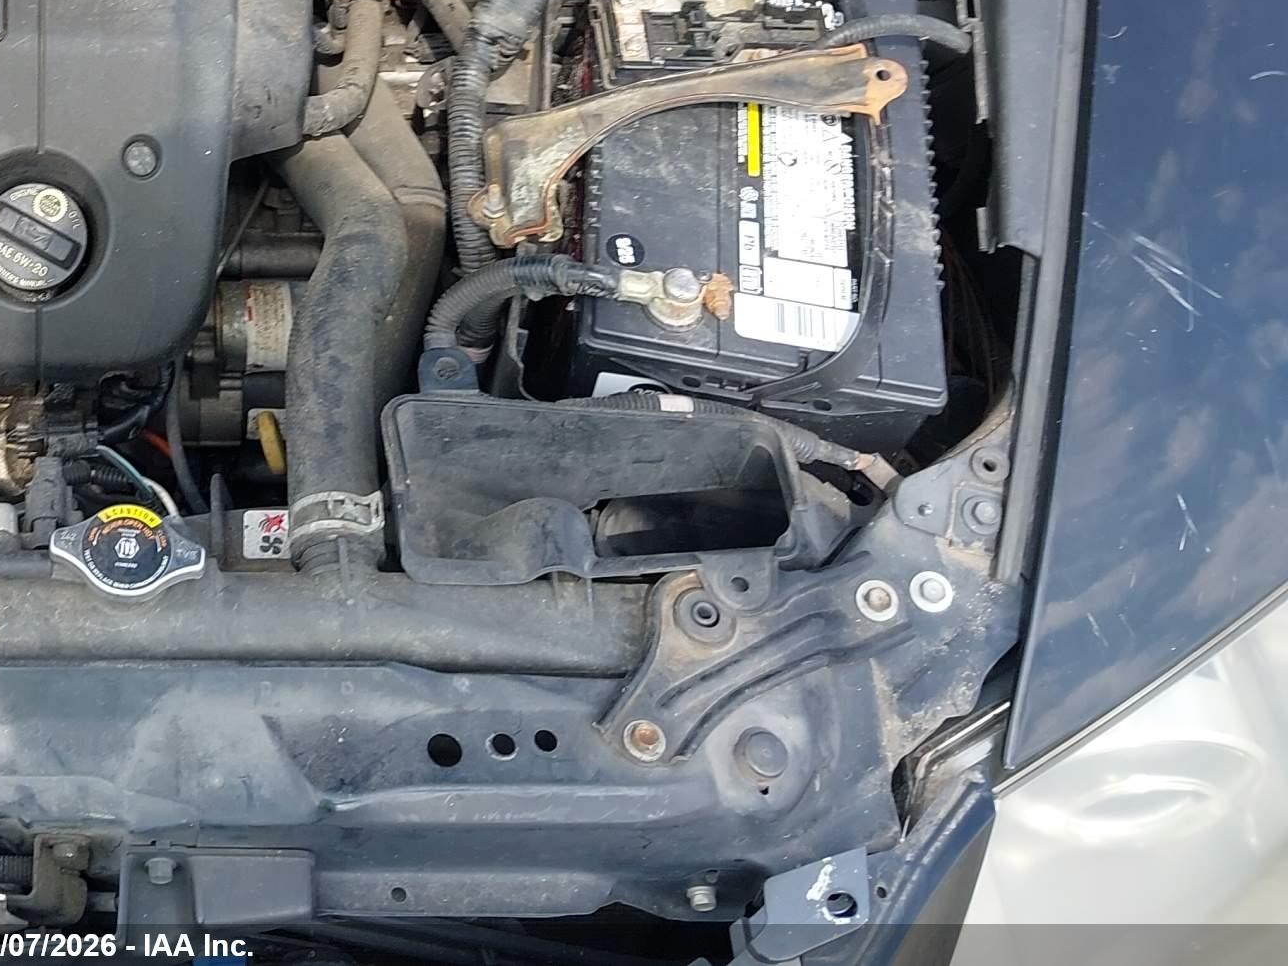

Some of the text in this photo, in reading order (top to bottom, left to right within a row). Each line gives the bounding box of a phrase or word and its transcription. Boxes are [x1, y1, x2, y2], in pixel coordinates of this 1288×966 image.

[68, 209, 81, 229] OIL
[13, 249, 48, 277] 5W-20
[112, 507, 156, 523] CAUTION
